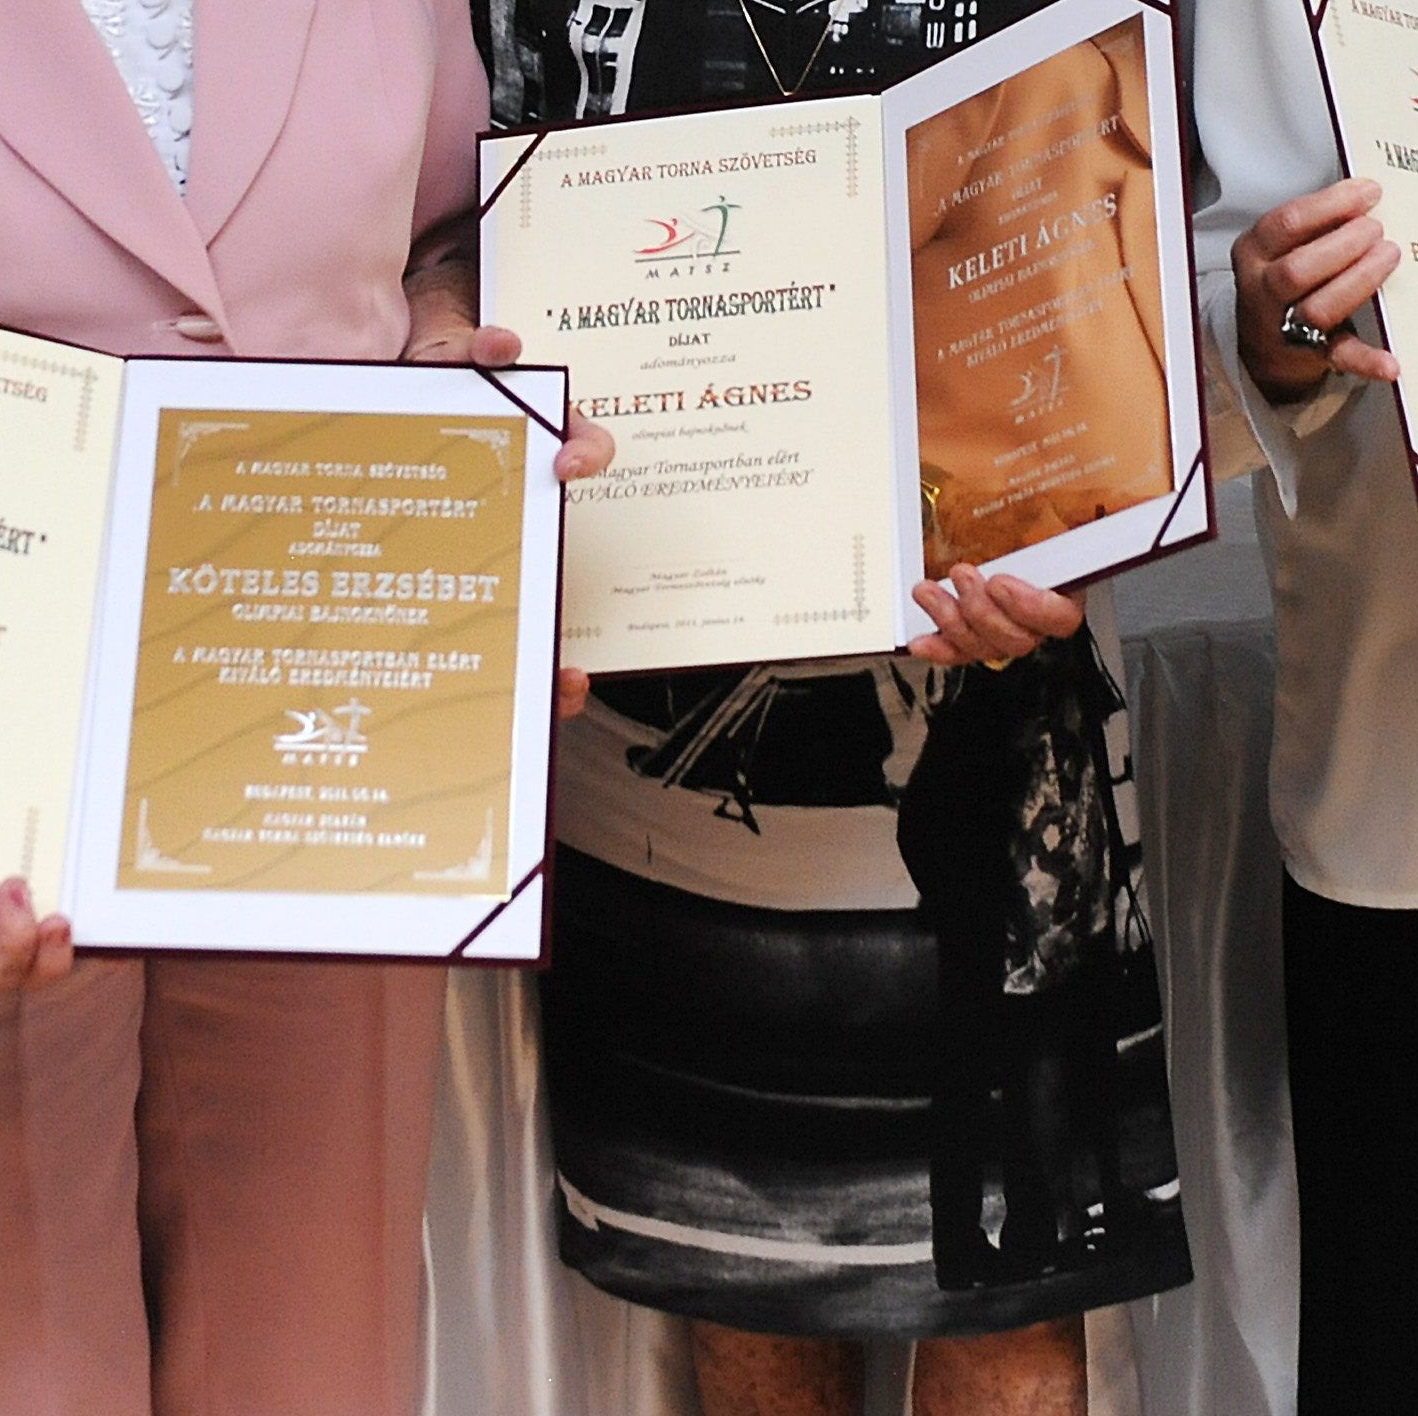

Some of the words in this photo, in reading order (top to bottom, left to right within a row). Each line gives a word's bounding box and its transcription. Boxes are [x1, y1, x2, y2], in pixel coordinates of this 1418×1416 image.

[558, 168, 572, 188] A
[576, 162, 652, 187] MAGYAR
[656, 158, 713, 180] TORNA
[717, 146, 820, 174] SZÖVETSÉG
[947, 230, 1028, 291] KELETI
[557, 306, 575, 333] A
[577, 293, 661, 331] MAGYAR
[665, 278, 827, 323] TORNASPORTÉRT
[667, 329, 712, 348] DÍJAT
[695, 373, 813, 411] ÁGNES
[652, 451, 763, 480] Tornasportban
[765, 446, 799, 466] elért
[166, 564, 321, 598] KÖTELES
[330, 566, 501, 603] ERZSÉBET
